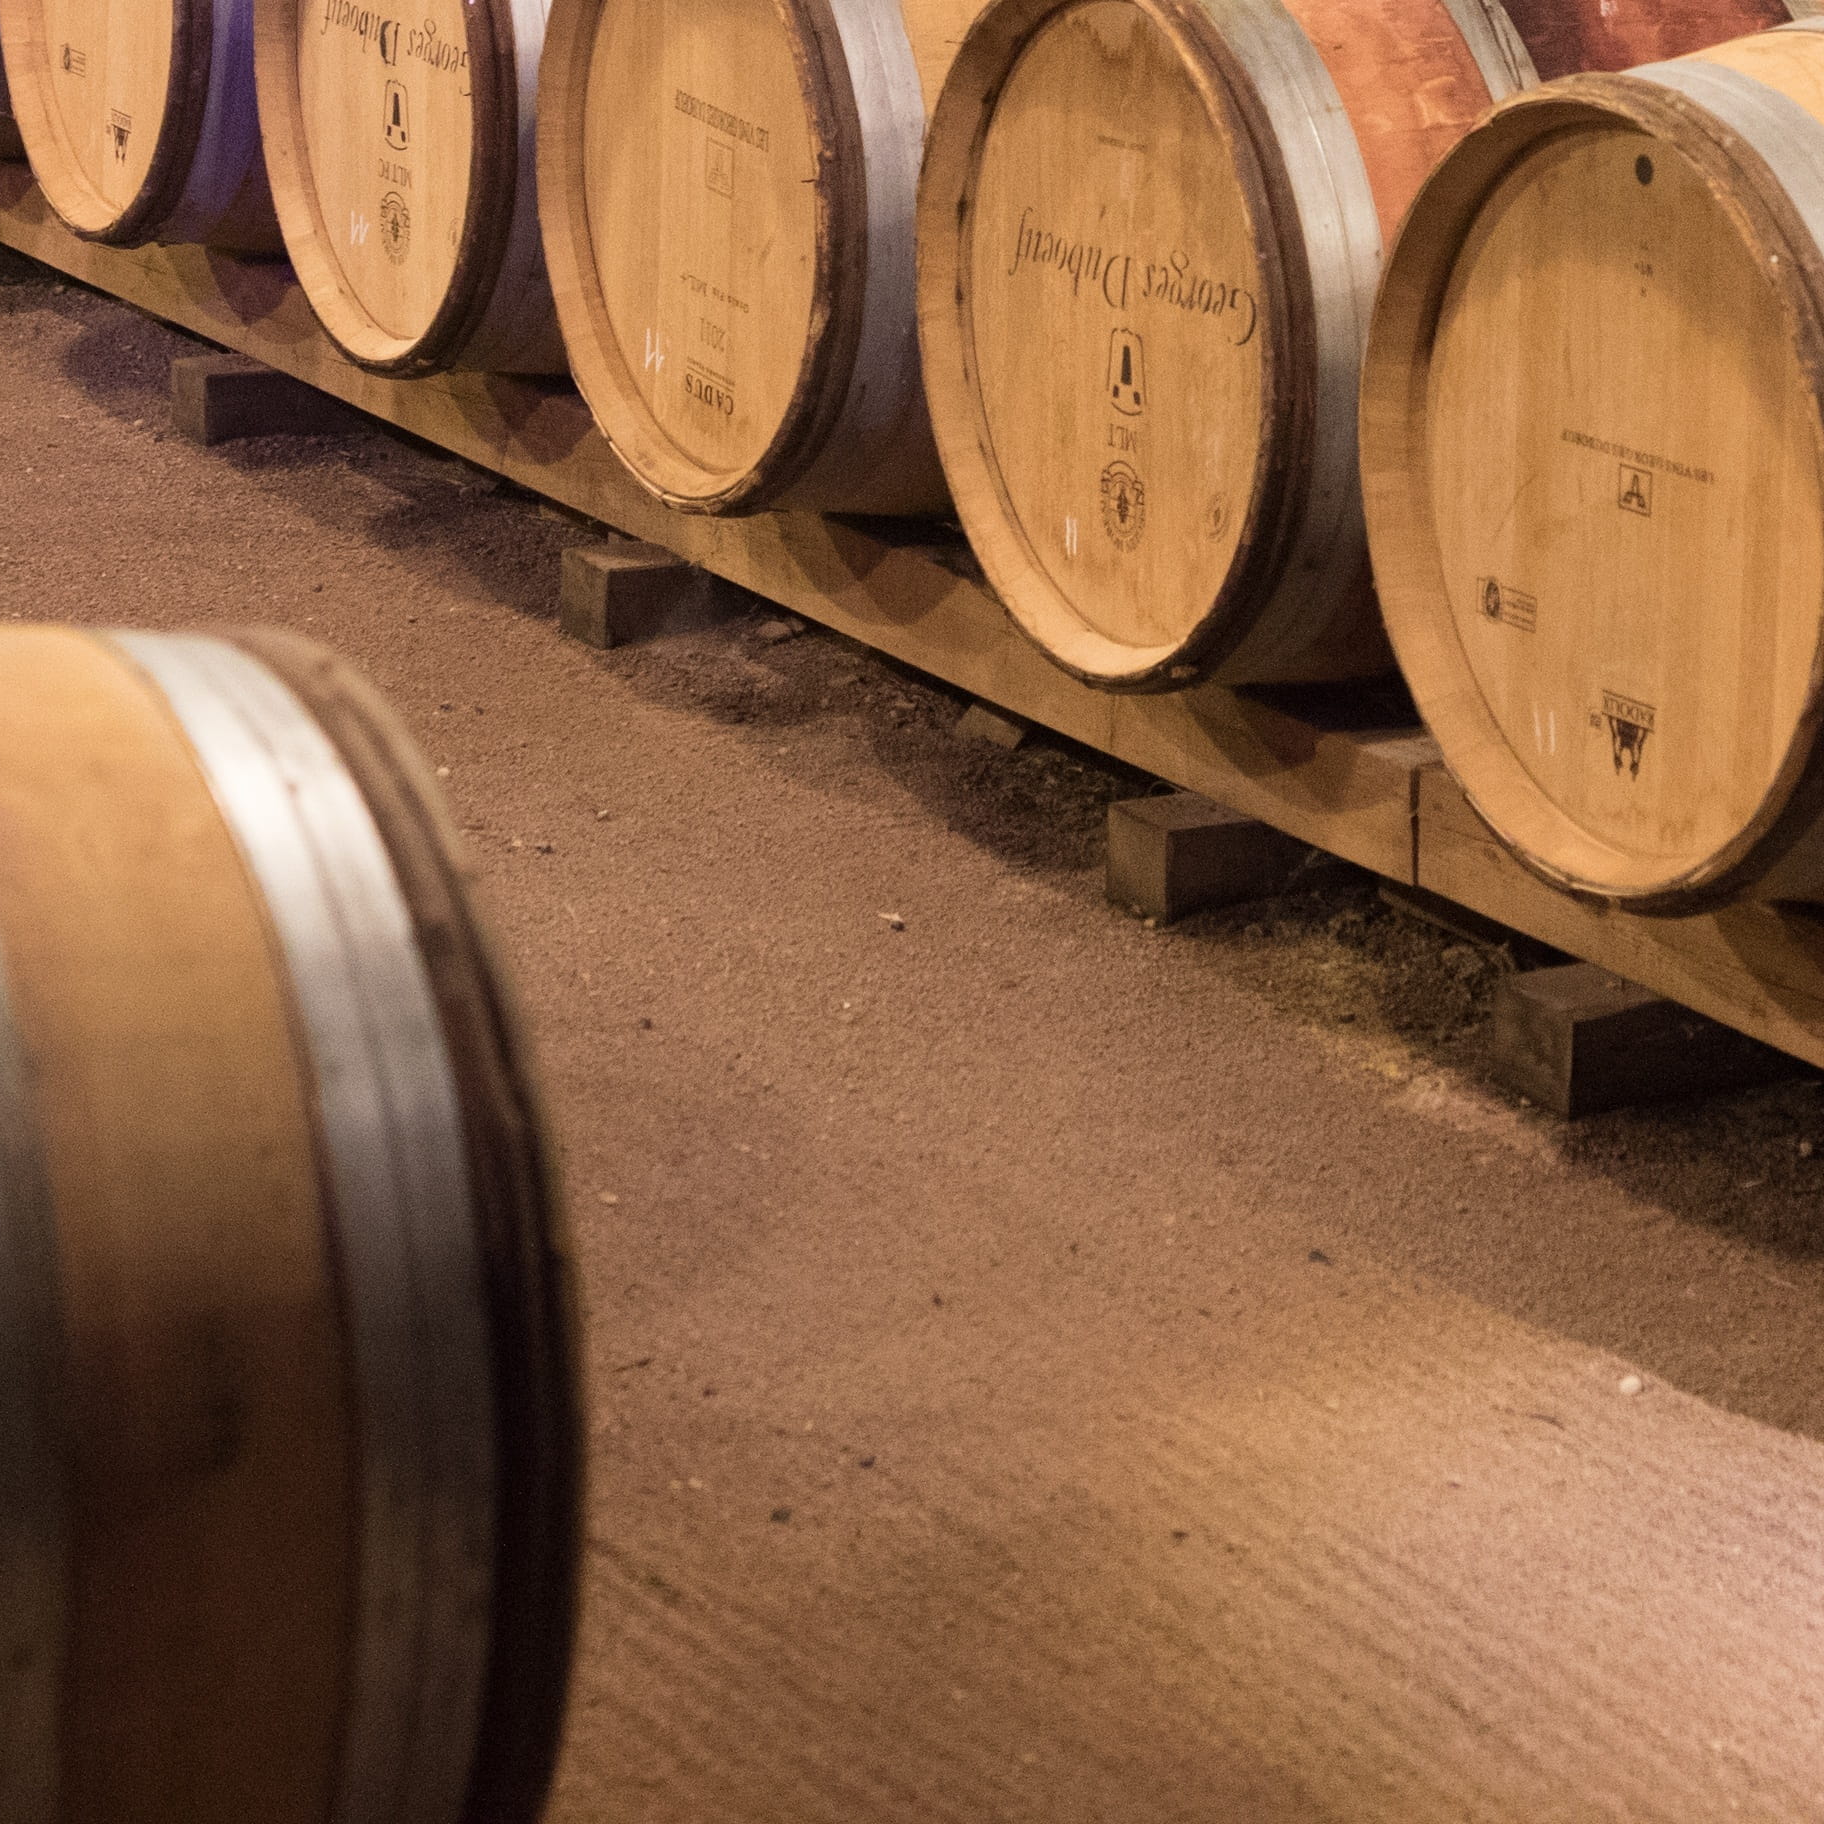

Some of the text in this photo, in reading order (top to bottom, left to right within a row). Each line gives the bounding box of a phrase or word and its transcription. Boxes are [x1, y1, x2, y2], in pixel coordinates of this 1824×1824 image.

[1007, 206, 1258, 348] Georges Duboeuf
[684, 373, 735, 416] CADUS
[1107, 423, 1138, 454] MLT
